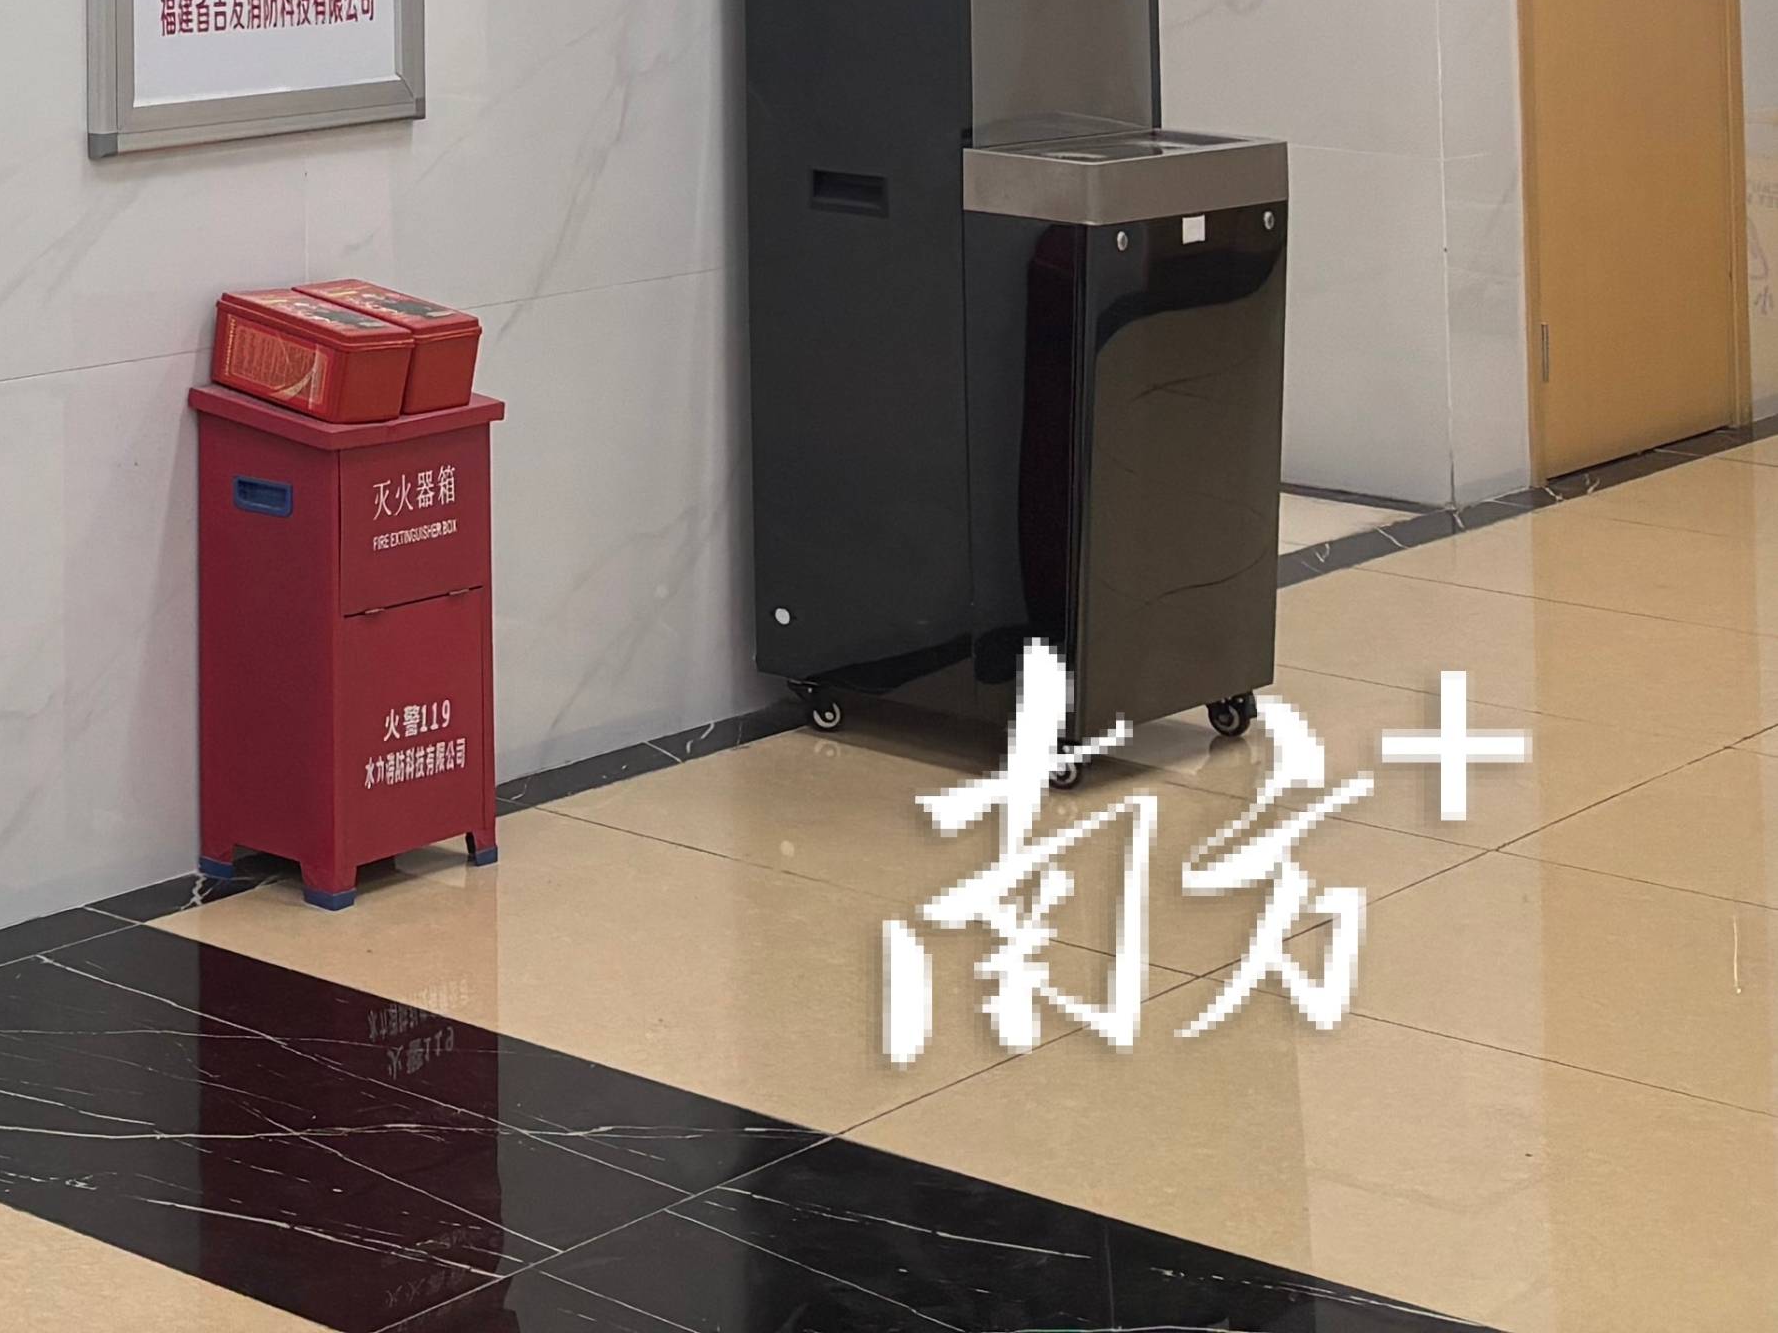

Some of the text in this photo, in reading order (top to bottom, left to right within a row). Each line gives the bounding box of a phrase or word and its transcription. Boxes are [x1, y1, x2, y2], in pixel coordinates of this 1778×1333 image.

[372, 464, 456, 521] 灭火器箱
[372, 533, 390, 551] FIRE
[390, 522, 442, 547] EXTINGUISHER
[383, 699, 451, 742] 火警119
